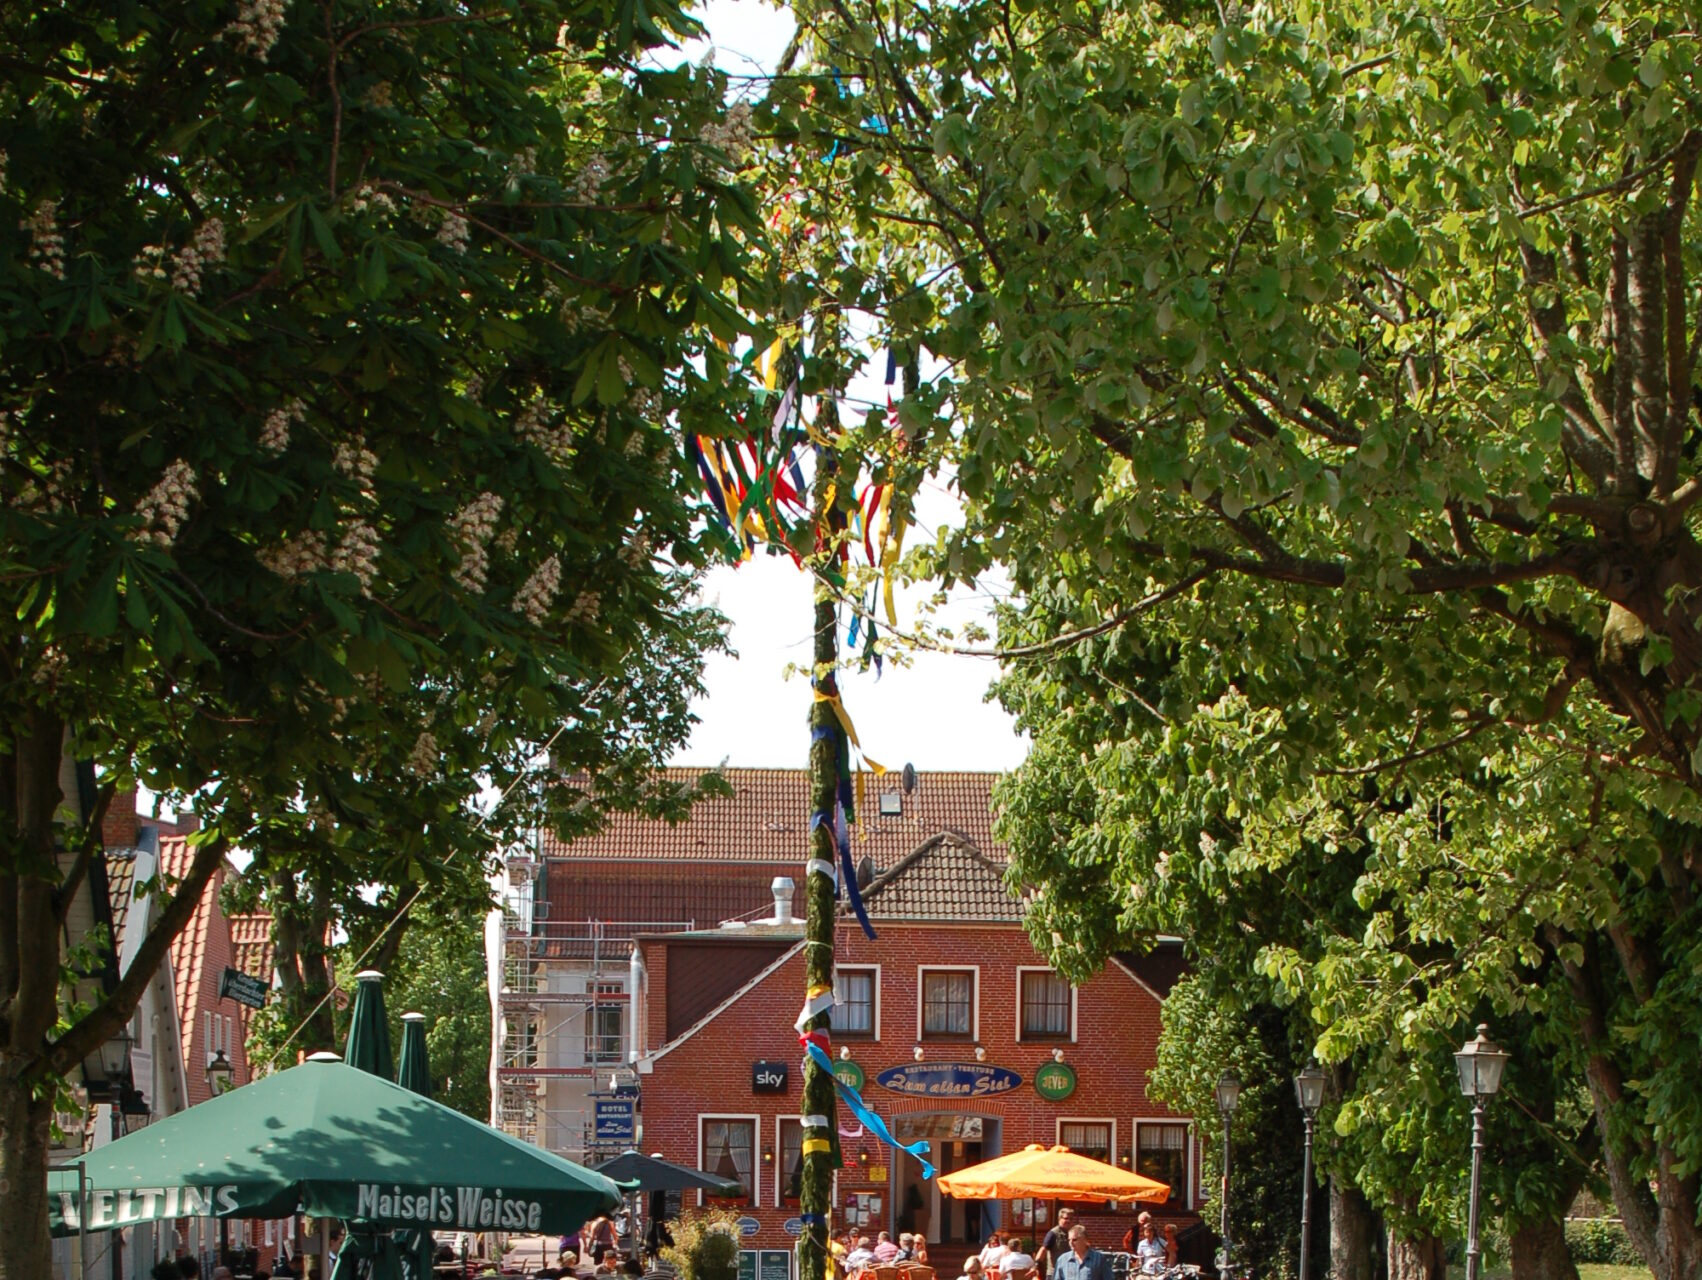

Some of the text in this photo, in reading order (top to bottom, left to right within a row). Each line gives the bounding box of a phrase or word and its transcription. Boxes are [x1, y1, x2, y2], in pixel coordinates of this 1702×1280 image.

[756, 1070, 784, 1087] sky
[905, 1065, 953, 1074] RESTAURANT
[886, 1074, 1011, 1095] Zum alten Siel
[1042, 1075, 1068, 1090] JEVER
[58, 1185, 240, 1231] VELTINS
[356, 1184, 543, 1231] Maisel's Weisse
